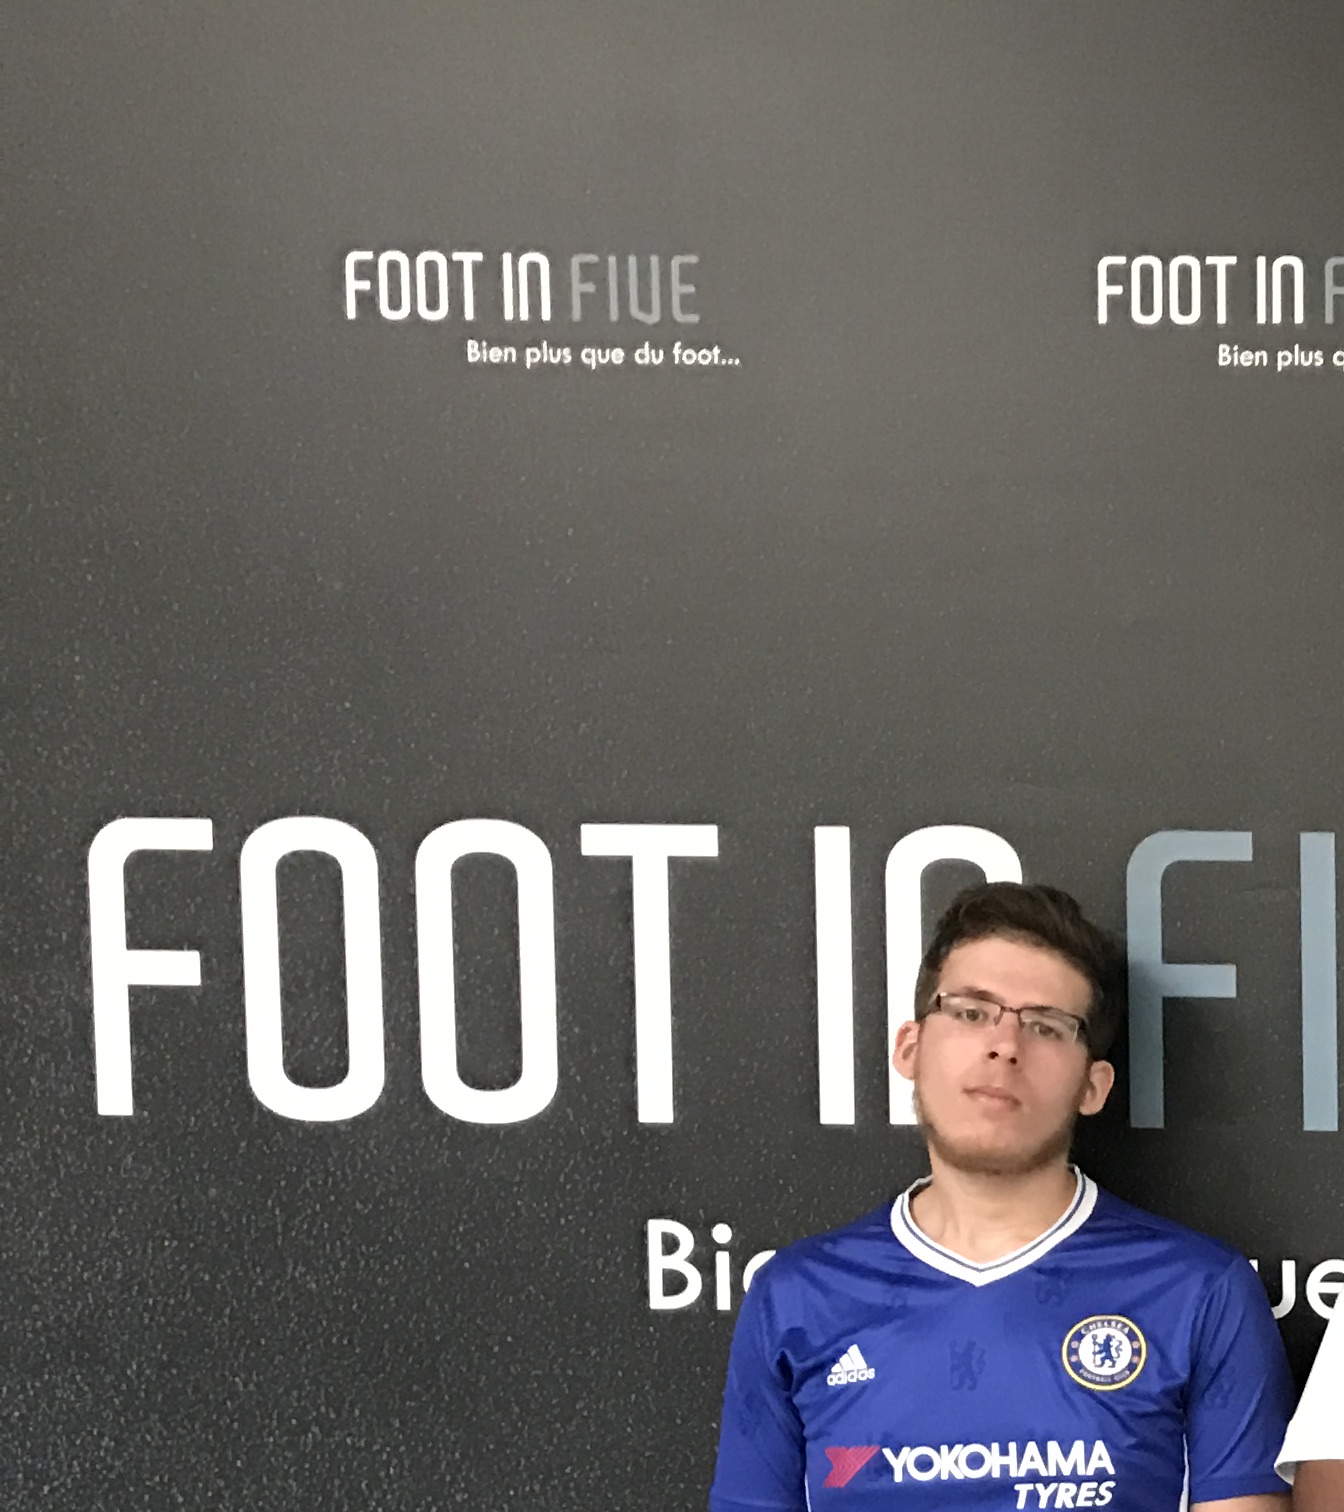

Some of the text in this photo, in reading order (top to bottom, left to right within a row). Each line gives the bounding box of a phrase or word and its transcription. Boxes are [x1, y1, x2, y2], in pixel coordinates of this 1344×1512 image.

[344, 250, 700, 324] FOOT IN FIVE
[1097, 254, 1238, 326] FOOT
[1256, 255, 1305, 325] IN
[467, 340, 741, 371] Bien plus que du foot...
[1218, 344, 1268, 367] Bien
[1277, 344, 1324, 372] plus
[87, 816, 719, 1124] FOOT
[826, 1366, 876, 1387] adidas
[882, 1439, 1116, 1483] YOKOHAMA
[1013, 1481, 1117, 1511] TYRES
